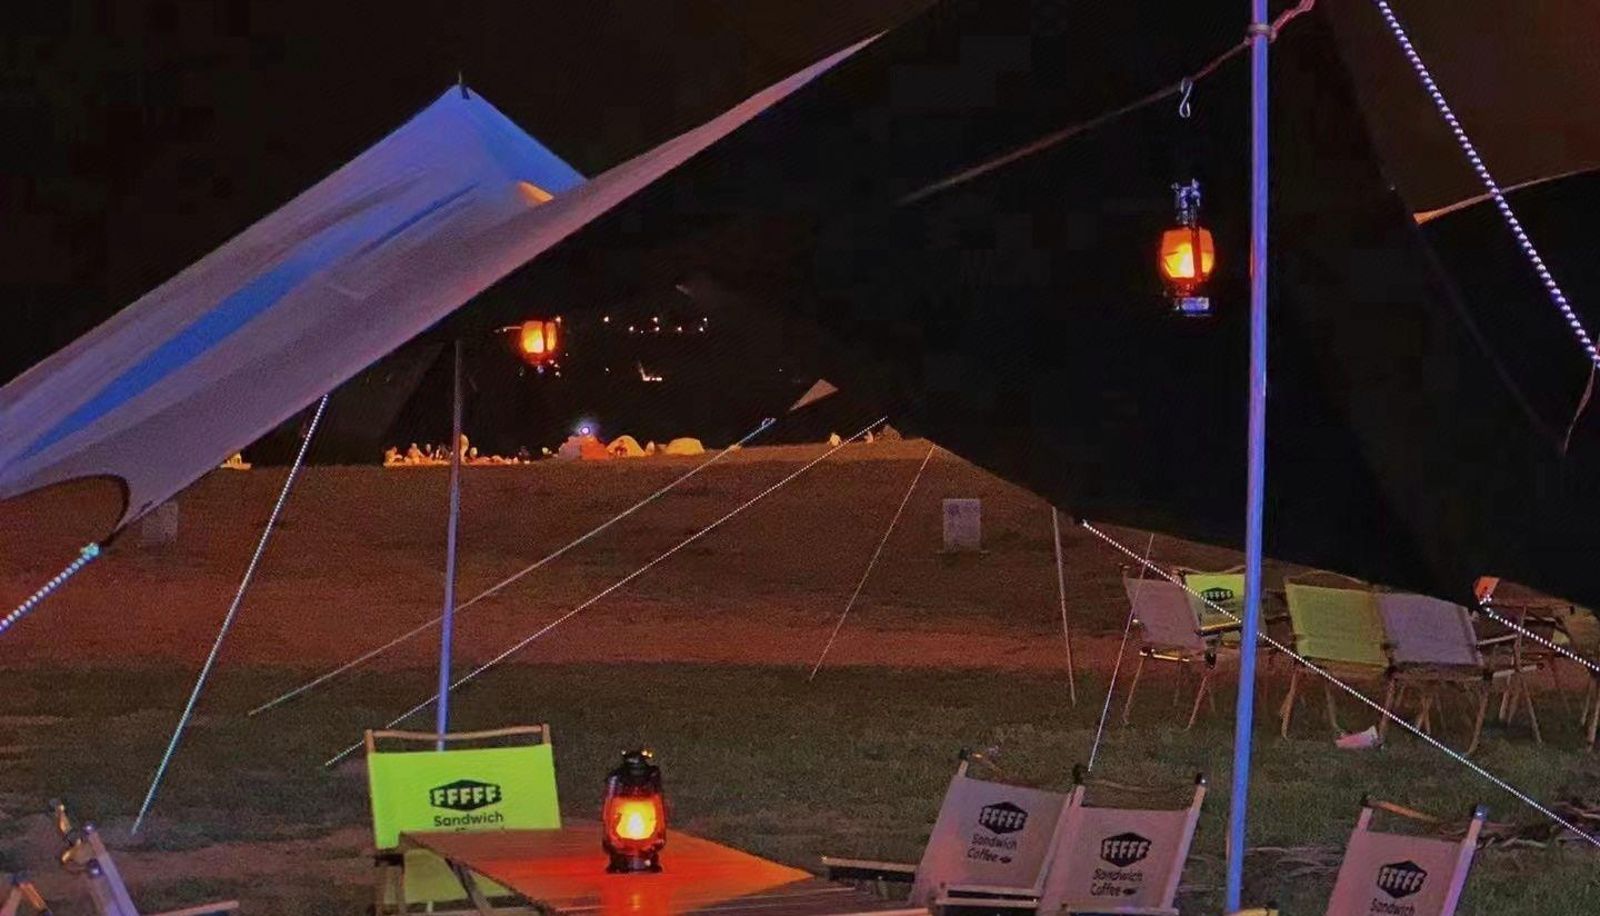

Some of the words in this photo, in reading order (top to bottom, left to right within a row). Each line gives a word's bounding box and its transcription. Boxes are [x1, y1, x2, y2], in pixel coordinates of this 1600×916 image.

[432, 785, 498, 806] FFFFF
[434, 811, 504, 827] Sandwich
[980, 806, 1025, 829] FFFFF
[971, 833, 1018, 851] Sandwich
[1102, 840, 1149, 859] FFFFF
[967, 847, 999, 862] Coffee
[1090, 882, 1121, 897] Coffee
